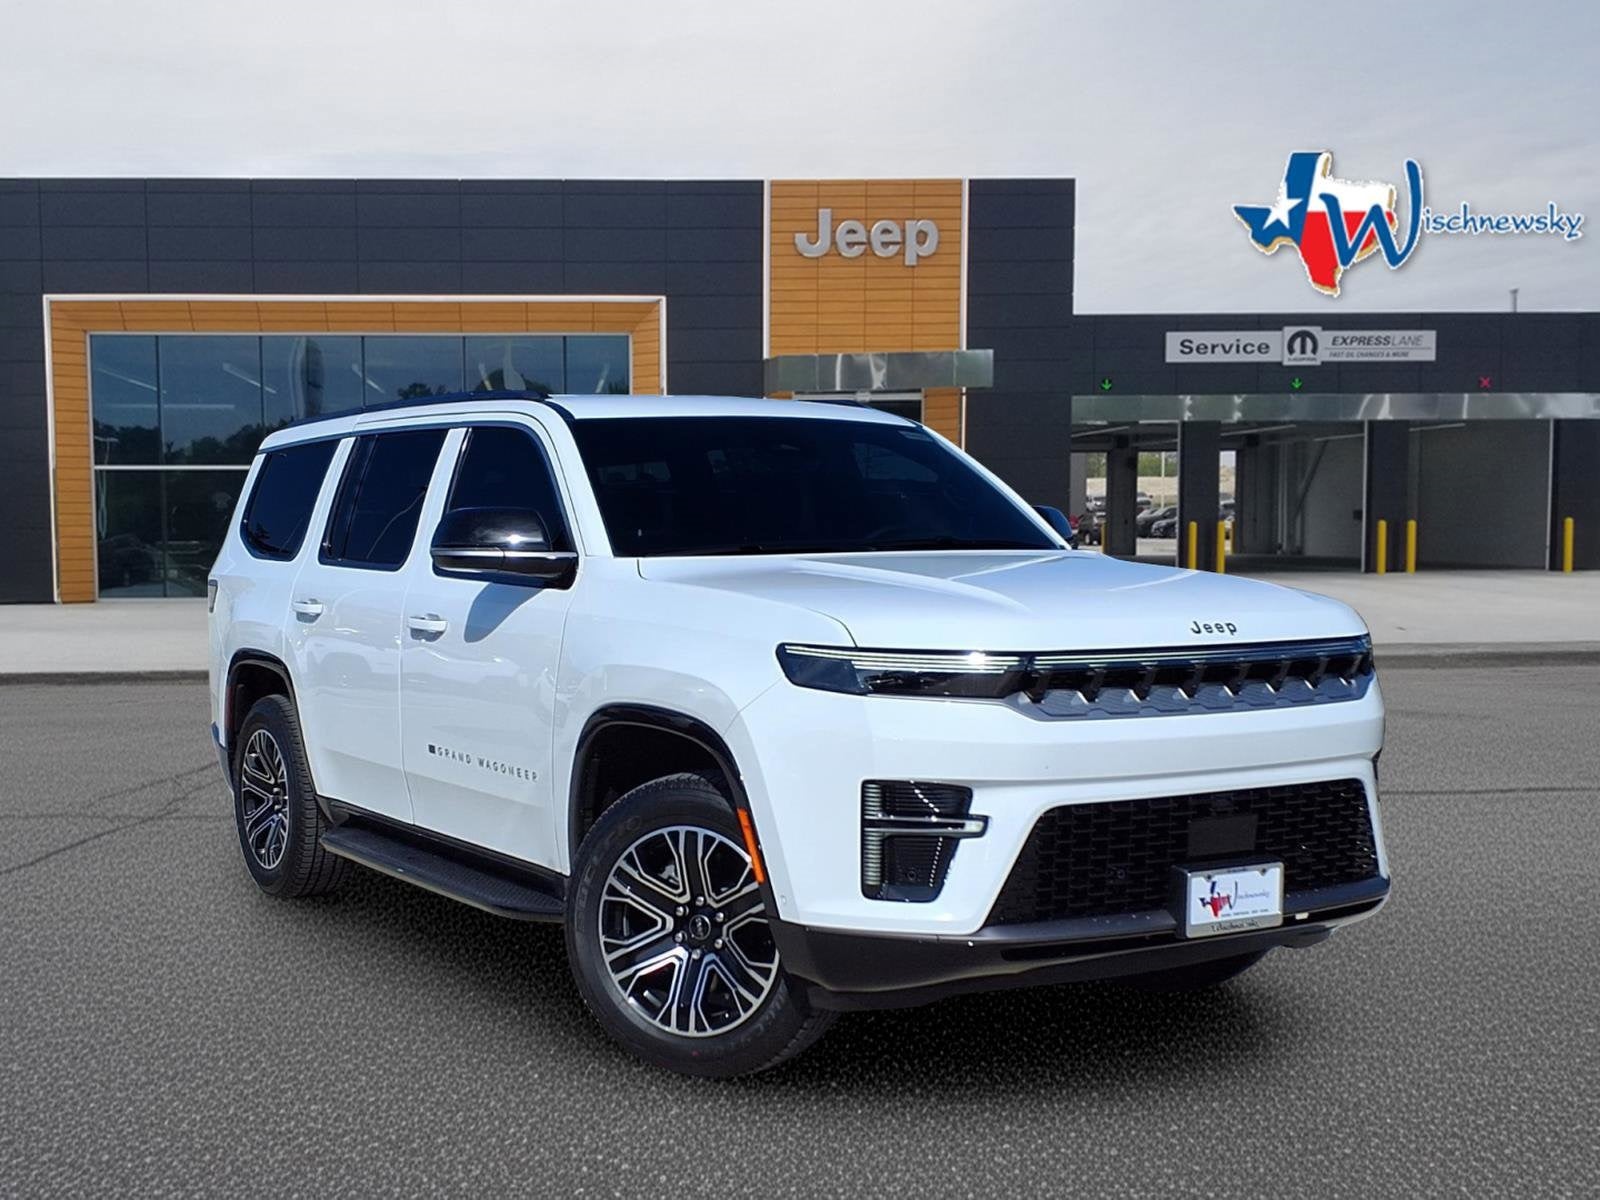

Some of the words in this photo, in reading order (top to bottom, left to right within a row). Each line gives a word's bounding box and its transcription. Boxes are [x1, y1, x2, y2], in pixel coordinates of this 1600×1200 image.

[794, 207, 939, 267] Jeep
[1179, 338, 1271, 355] Service
[1190, 620, 1237, 636] Jeep
[437, 746, 472, 765] GRAND
[478, 757, 538, 781] WAGONEER
